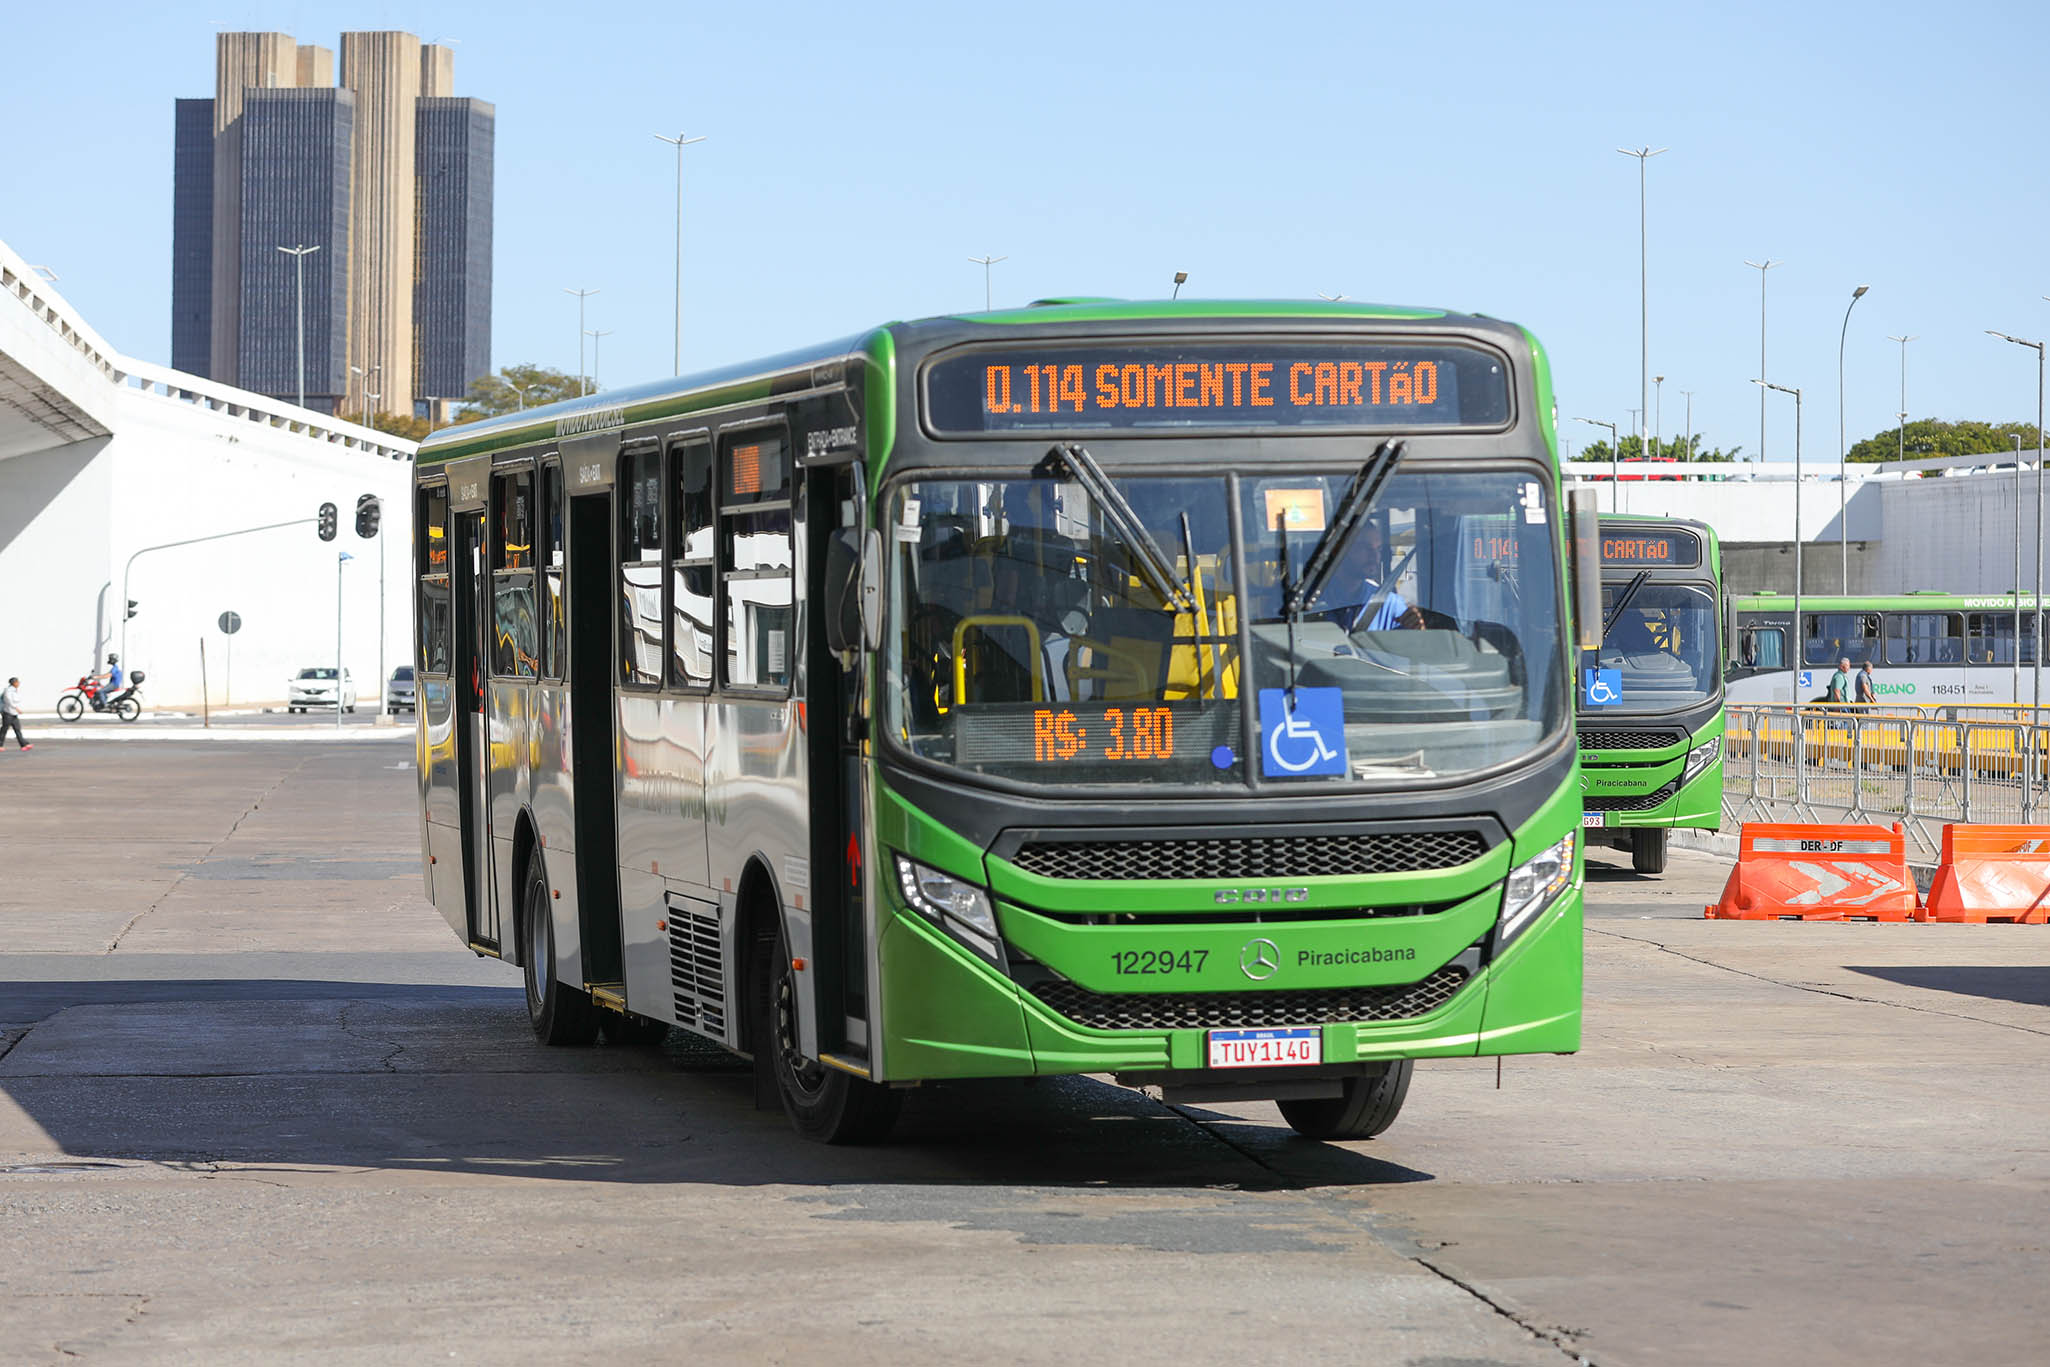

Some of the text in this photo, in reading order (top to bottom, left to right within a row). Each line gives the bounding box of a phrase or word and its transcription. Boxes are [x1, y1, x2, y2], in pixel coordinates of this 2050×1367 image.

[986, 361, 1438, 414] 0.114 SOMENTE CARTÃO
[1964, 598, 2004, 607] MOVIDO
[1932, 685, 1966, 695] 118451
[1034, 707, 1174, 761] R$: 3.80
[1596, 779, 1648, 787] Piracicabana
[1801, 840, 1821, 851] DER
[1111, 950, 1210, 974] 122947
[1298, 947, 1416, 966] Piracicabana
